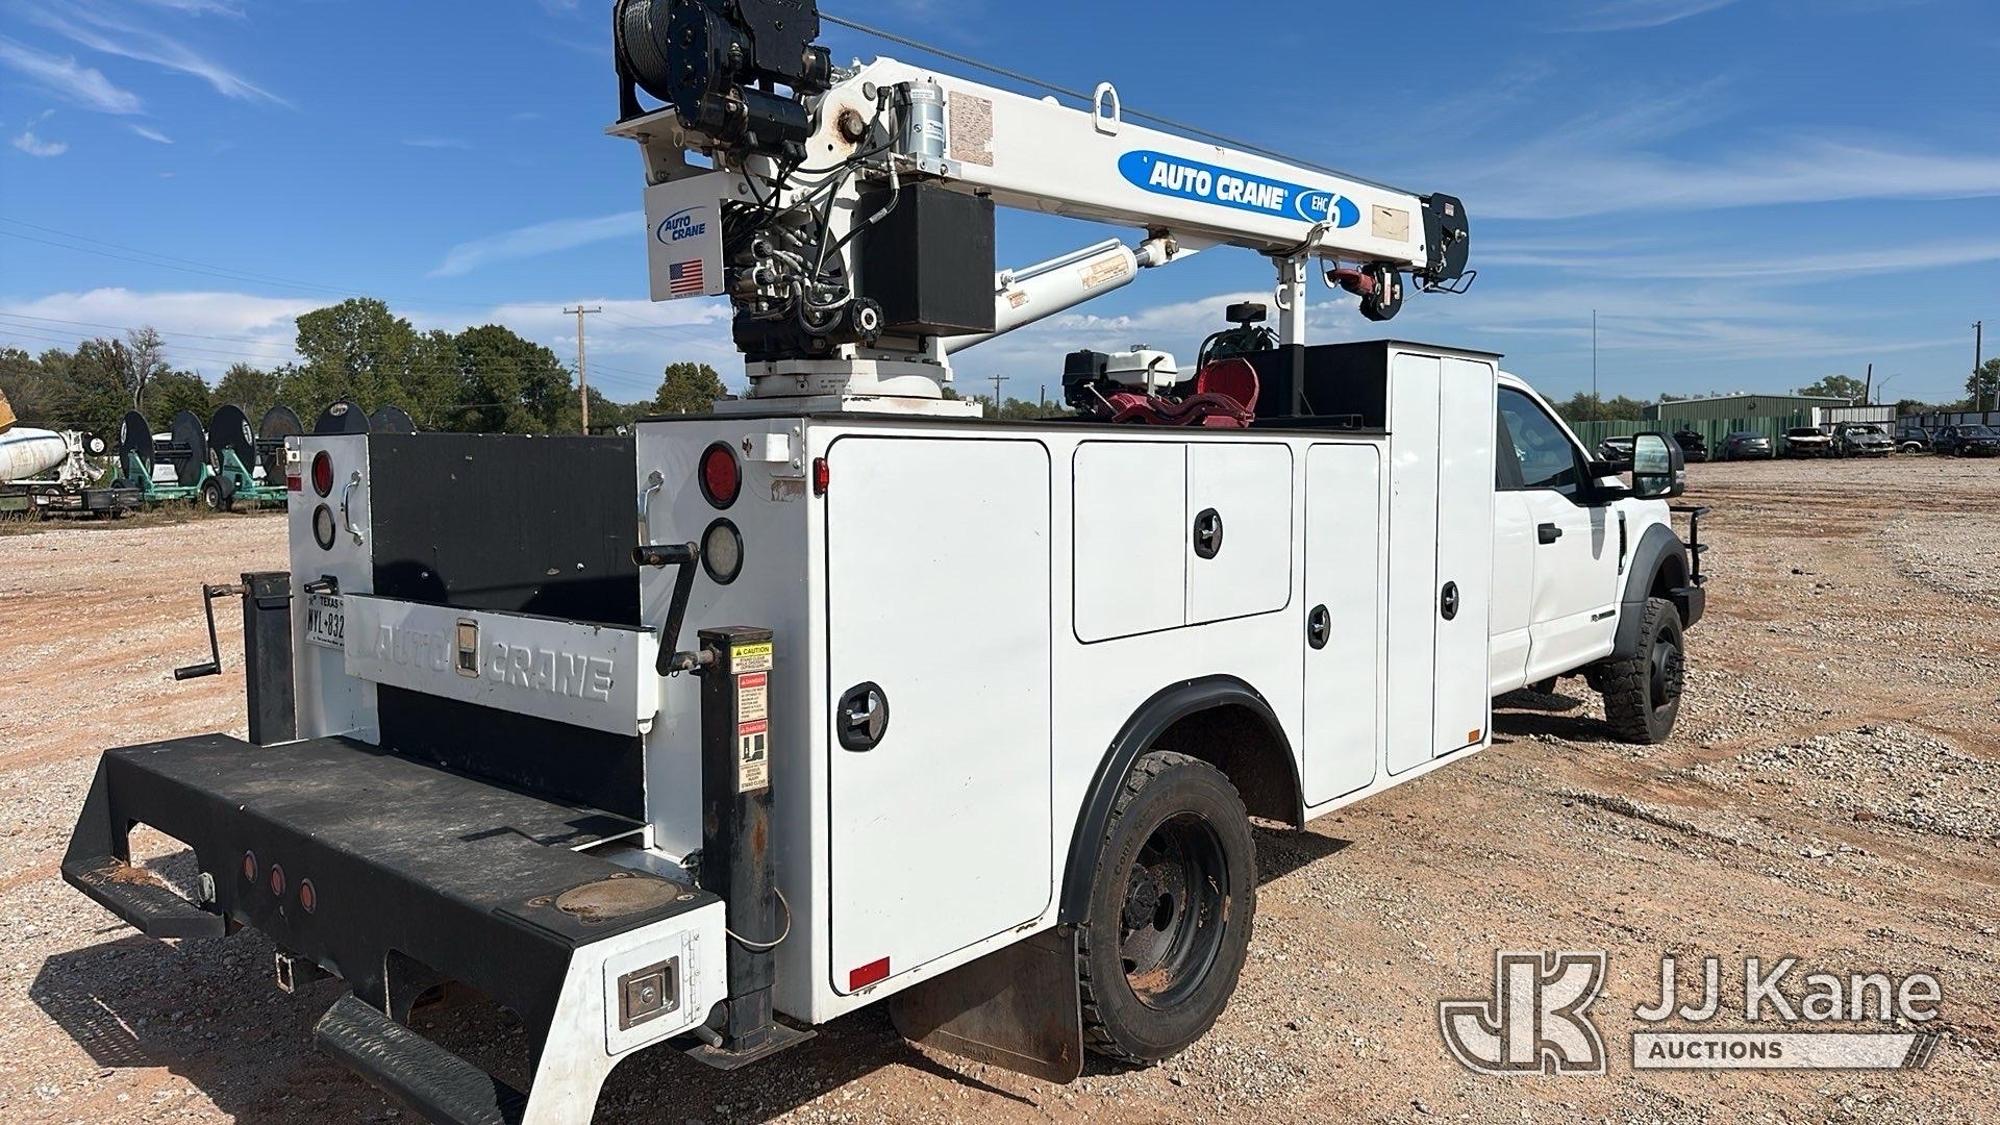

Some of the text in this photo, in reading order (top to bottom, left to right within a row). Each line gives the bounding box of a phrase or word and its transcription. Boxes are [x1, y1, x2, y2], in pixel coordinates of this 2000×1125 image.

[1149, 160, 1285, 211] AUTO CRANE
[1311, 193, 1341, 228] EHC 6
[665, 215, 691, 231] AUTO
[672, 223, 706, 241] CRANE
[320, 595, 338, 608] TEXAS
[743, 646, 770, 655] CAUTION
[374, 624, 614, 702] AUTO CRANE
